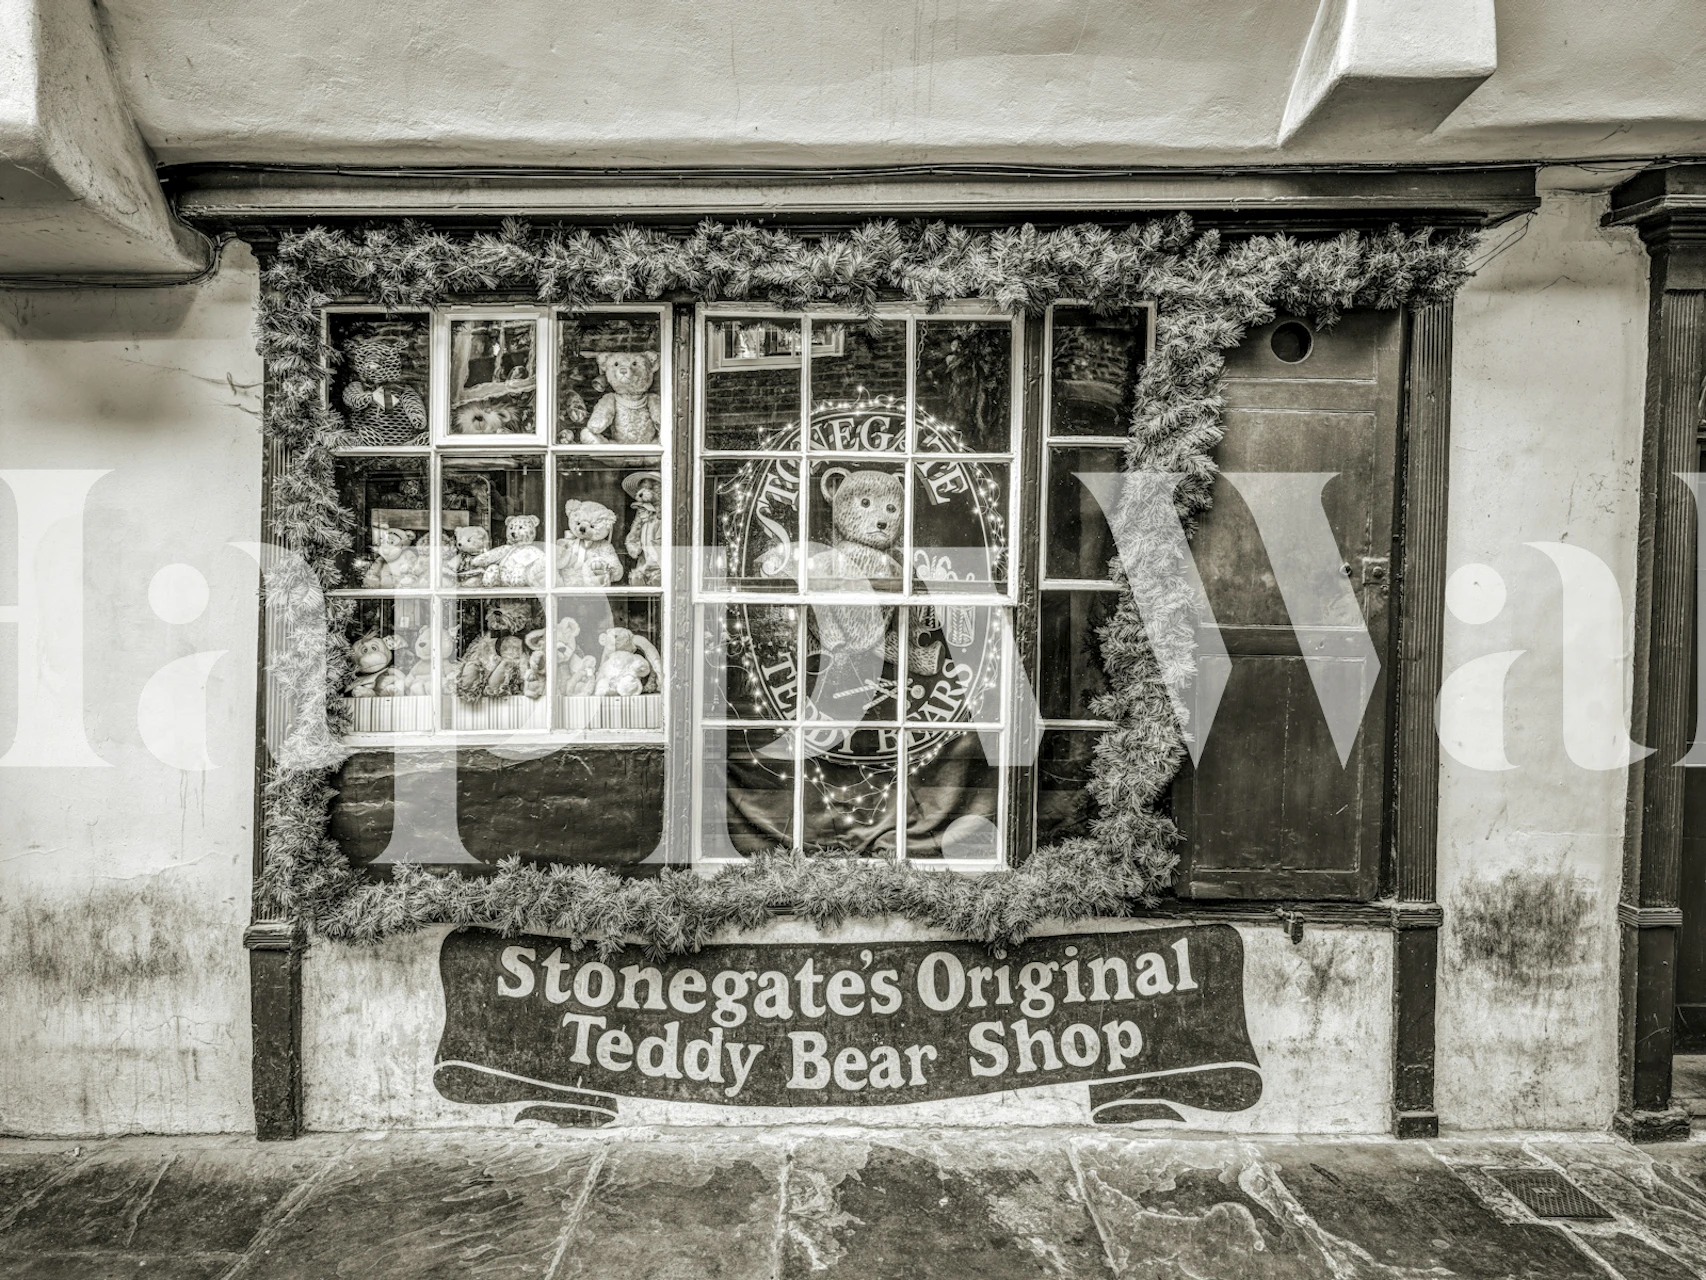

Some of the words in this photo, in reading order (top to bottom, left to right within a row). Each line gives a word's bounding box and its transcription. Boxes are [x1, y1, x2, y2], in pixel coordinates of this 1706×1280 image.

[497, 945, 902, 1027] Stonegate's
[916, 937, 1199, 1018] Original
[562, 1011, 765, 1098] Teddy
[786, 1031, 938, 1091] Bear
[968, 1018, 1144, 1077] Shop
